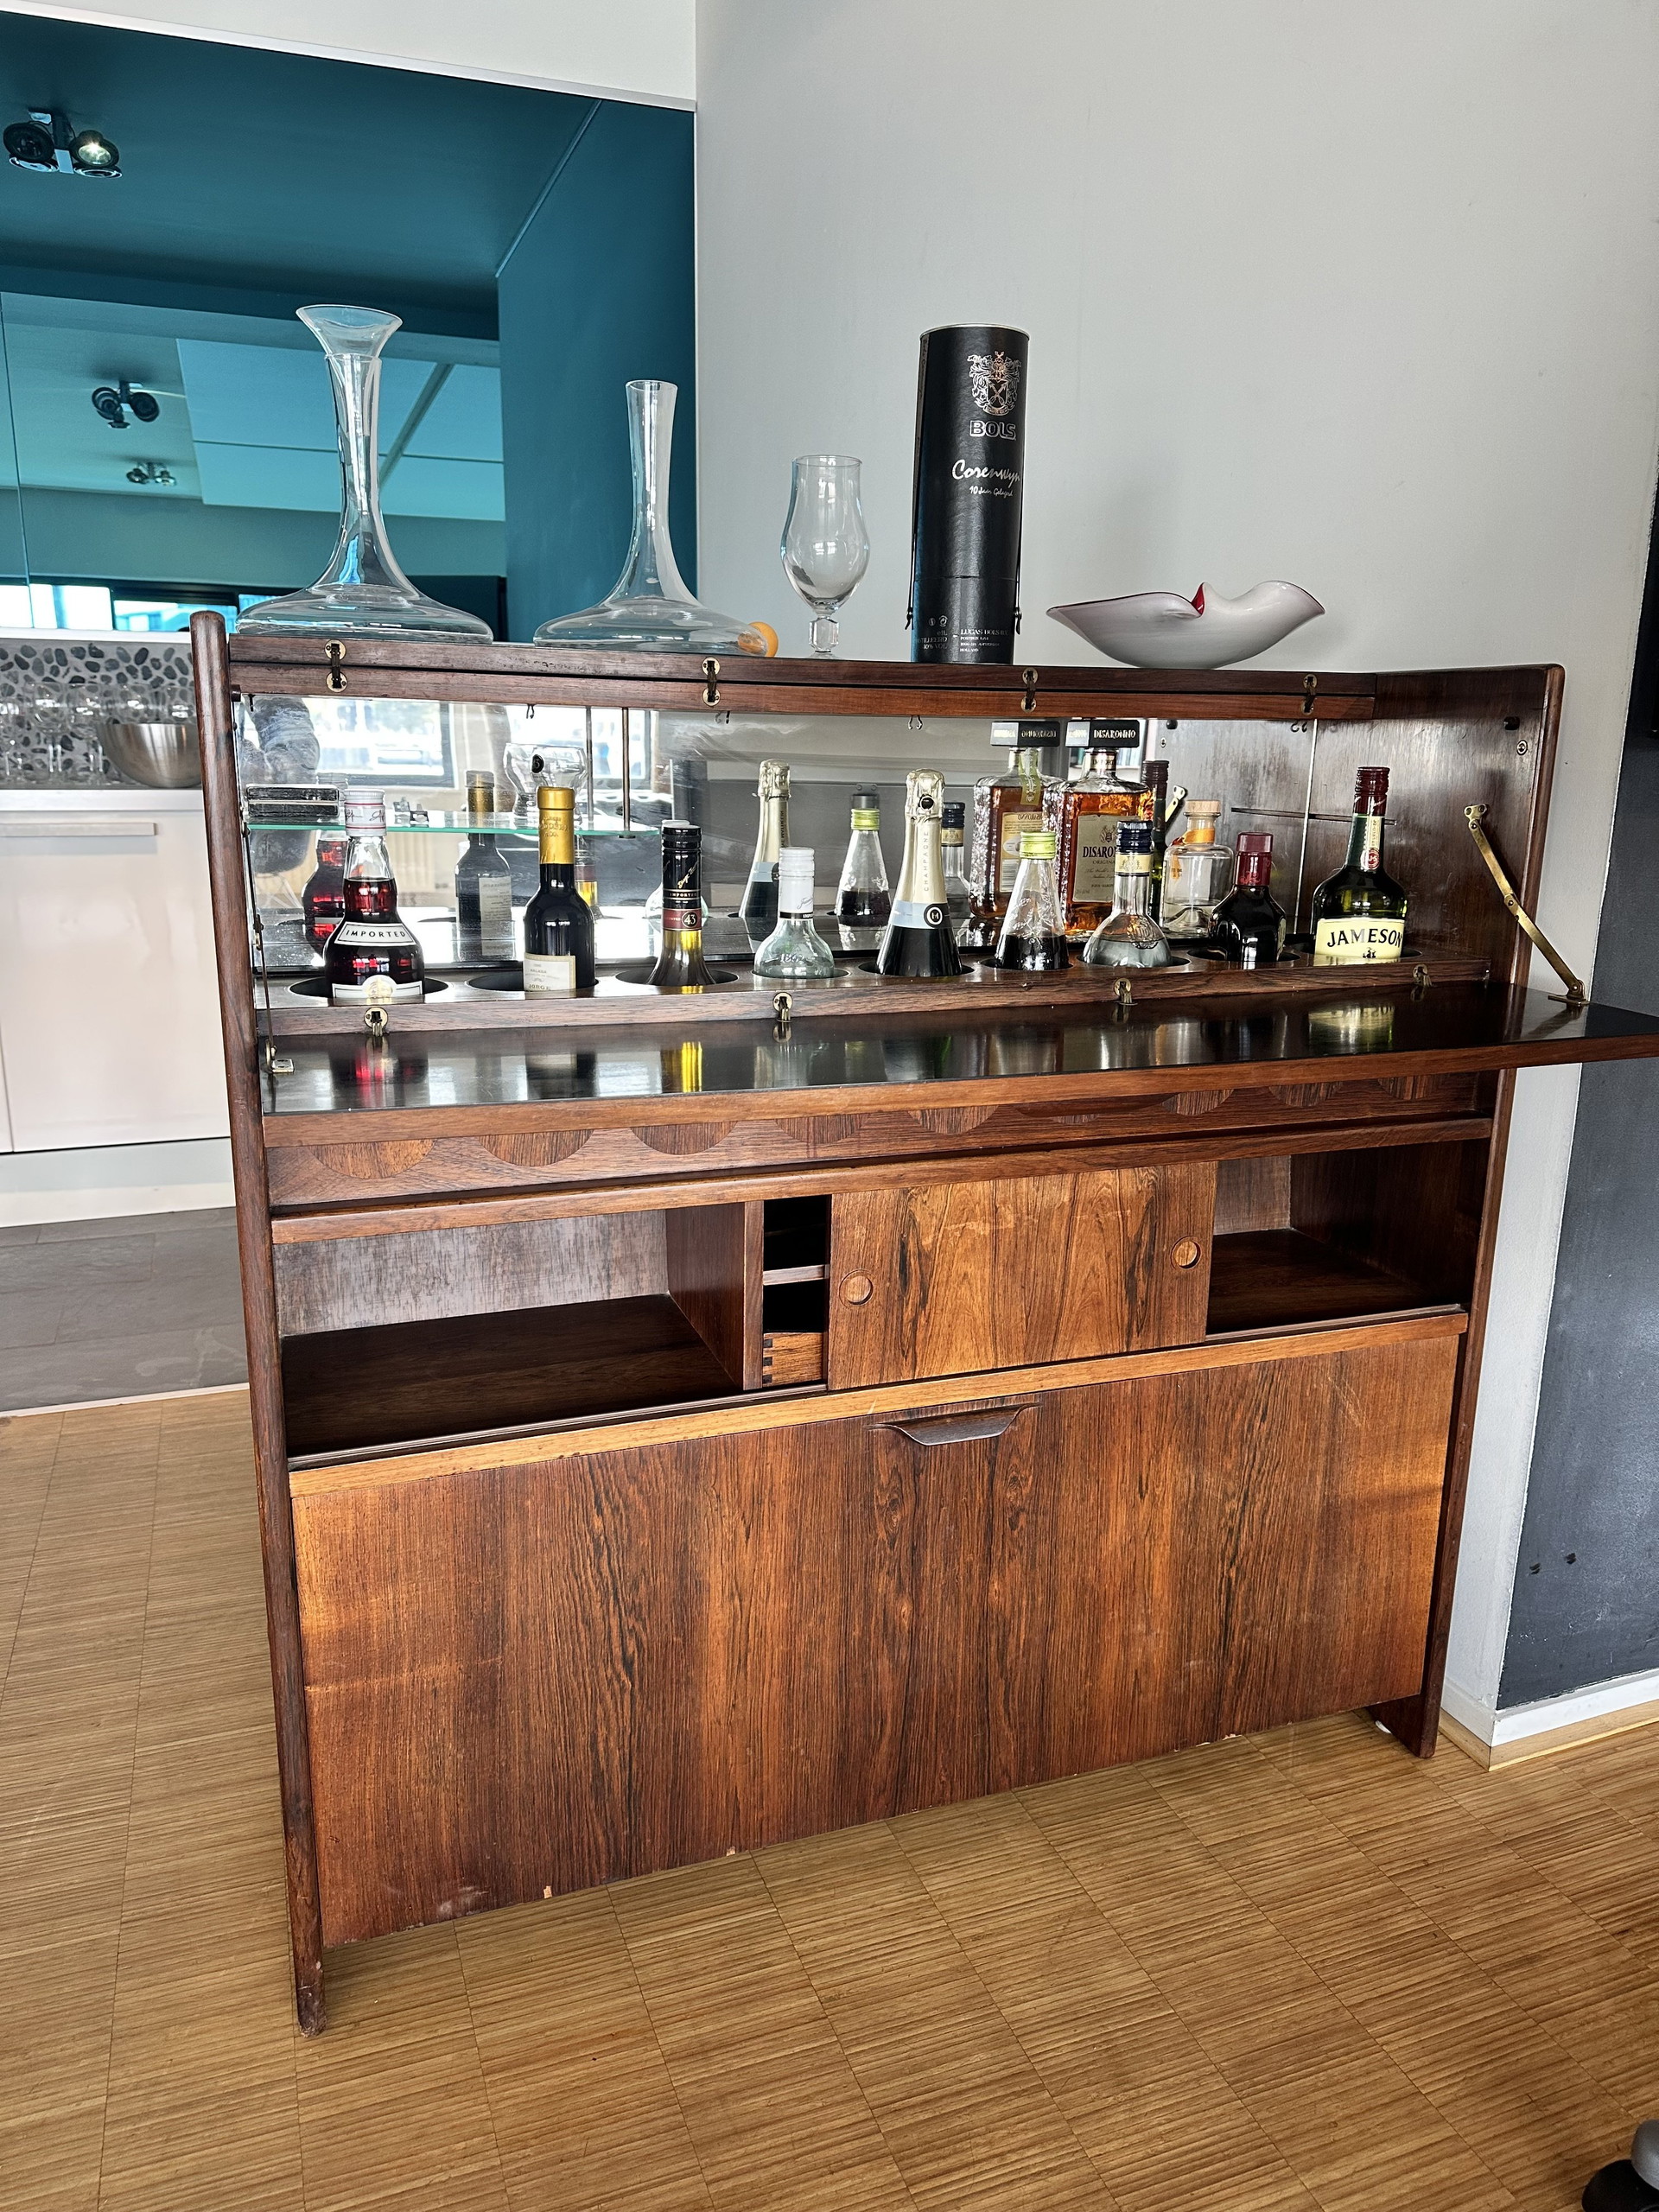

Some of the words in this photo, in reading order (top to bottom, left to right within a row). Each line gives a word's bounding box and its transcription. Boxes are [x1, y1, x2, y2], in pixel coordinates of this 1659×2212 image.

[969, 420, 1017, 441] BOLS
[969, 485, 978, 494] 10
[1093, 729, 1136, 739] DISARONNO
[1082, 846, 1116, 859] DISARO
[683, 914, 696, 925] 43
[346, 929, 406, 938] IMPORTED
[1326, 928, 1402, 948] JAMESON
